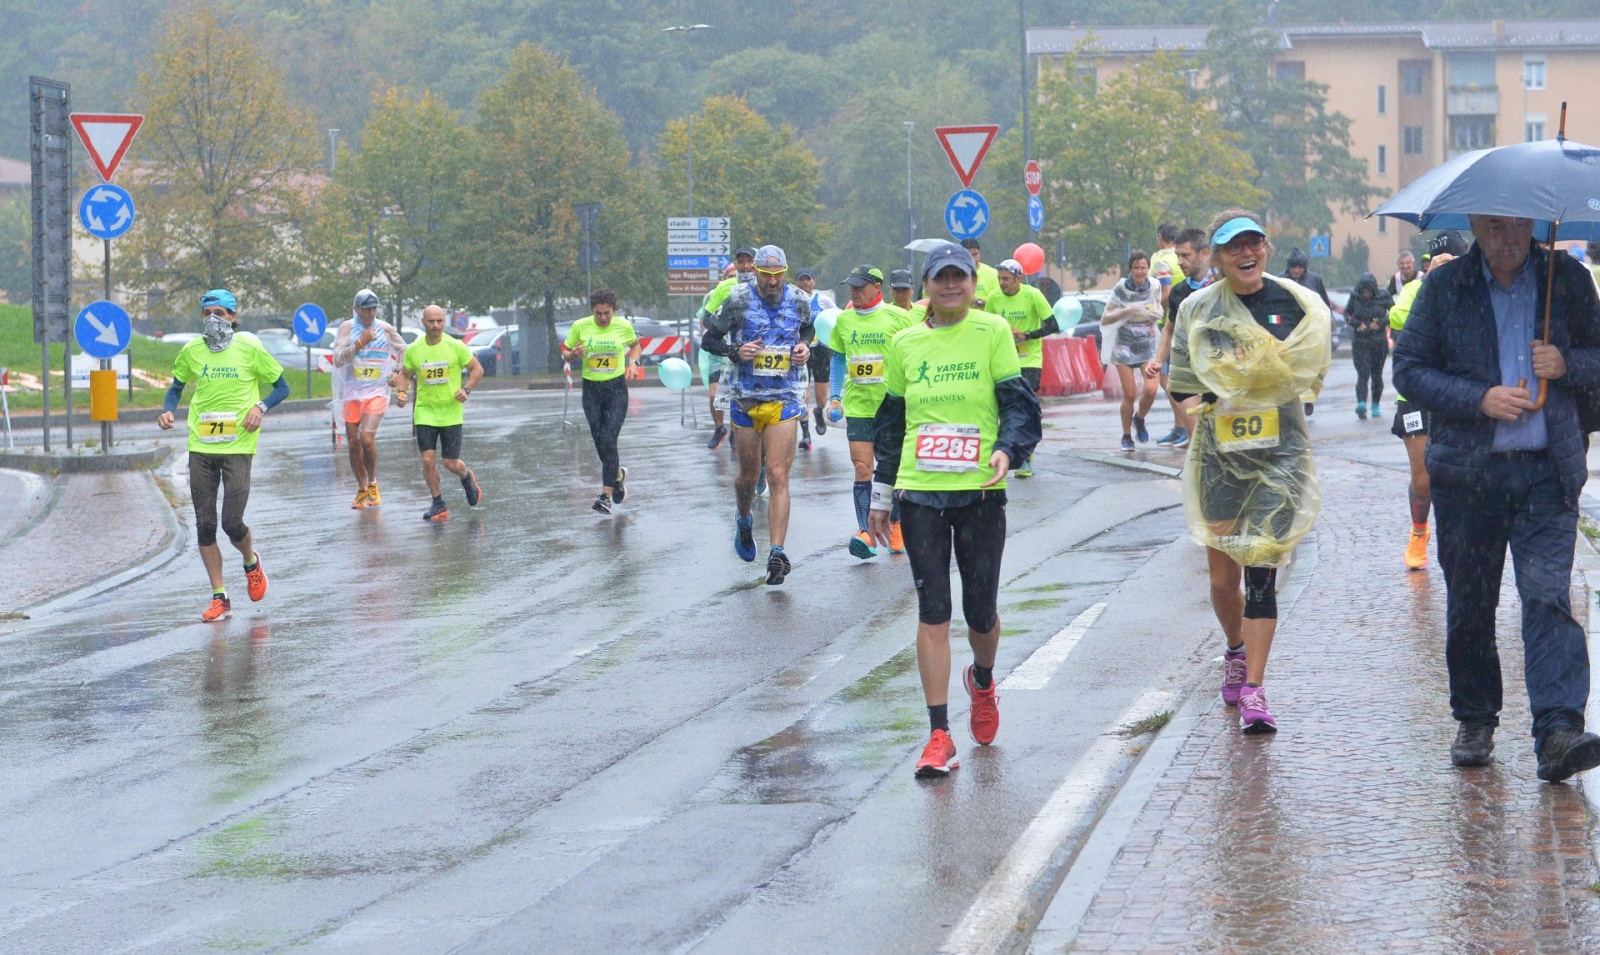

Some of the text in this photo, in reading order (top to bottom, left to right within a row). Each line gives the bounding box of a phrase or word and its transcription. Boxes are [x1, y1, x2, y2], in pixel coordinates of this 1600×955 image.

[1025, 171, 1041, 184] STOP
[669, 258, 699, 266] LAVENO
[596, 358, 610, 368] 74
[764, 354, 784, 369] 97
[936, 362, 977, 373] VARESE
[362, 368, 374, 377] 47
[426, 368, 444, 379] 219
[856, 364, 873, 376] 69
[933, 371, 980, 383] CITYRUN
[919, 394, 965, 405] HUMANITAS
[210, 422, 224, 434] 71
[1231, 415, 1262, 438] 60
[917, 437, 979, 460] 2285
